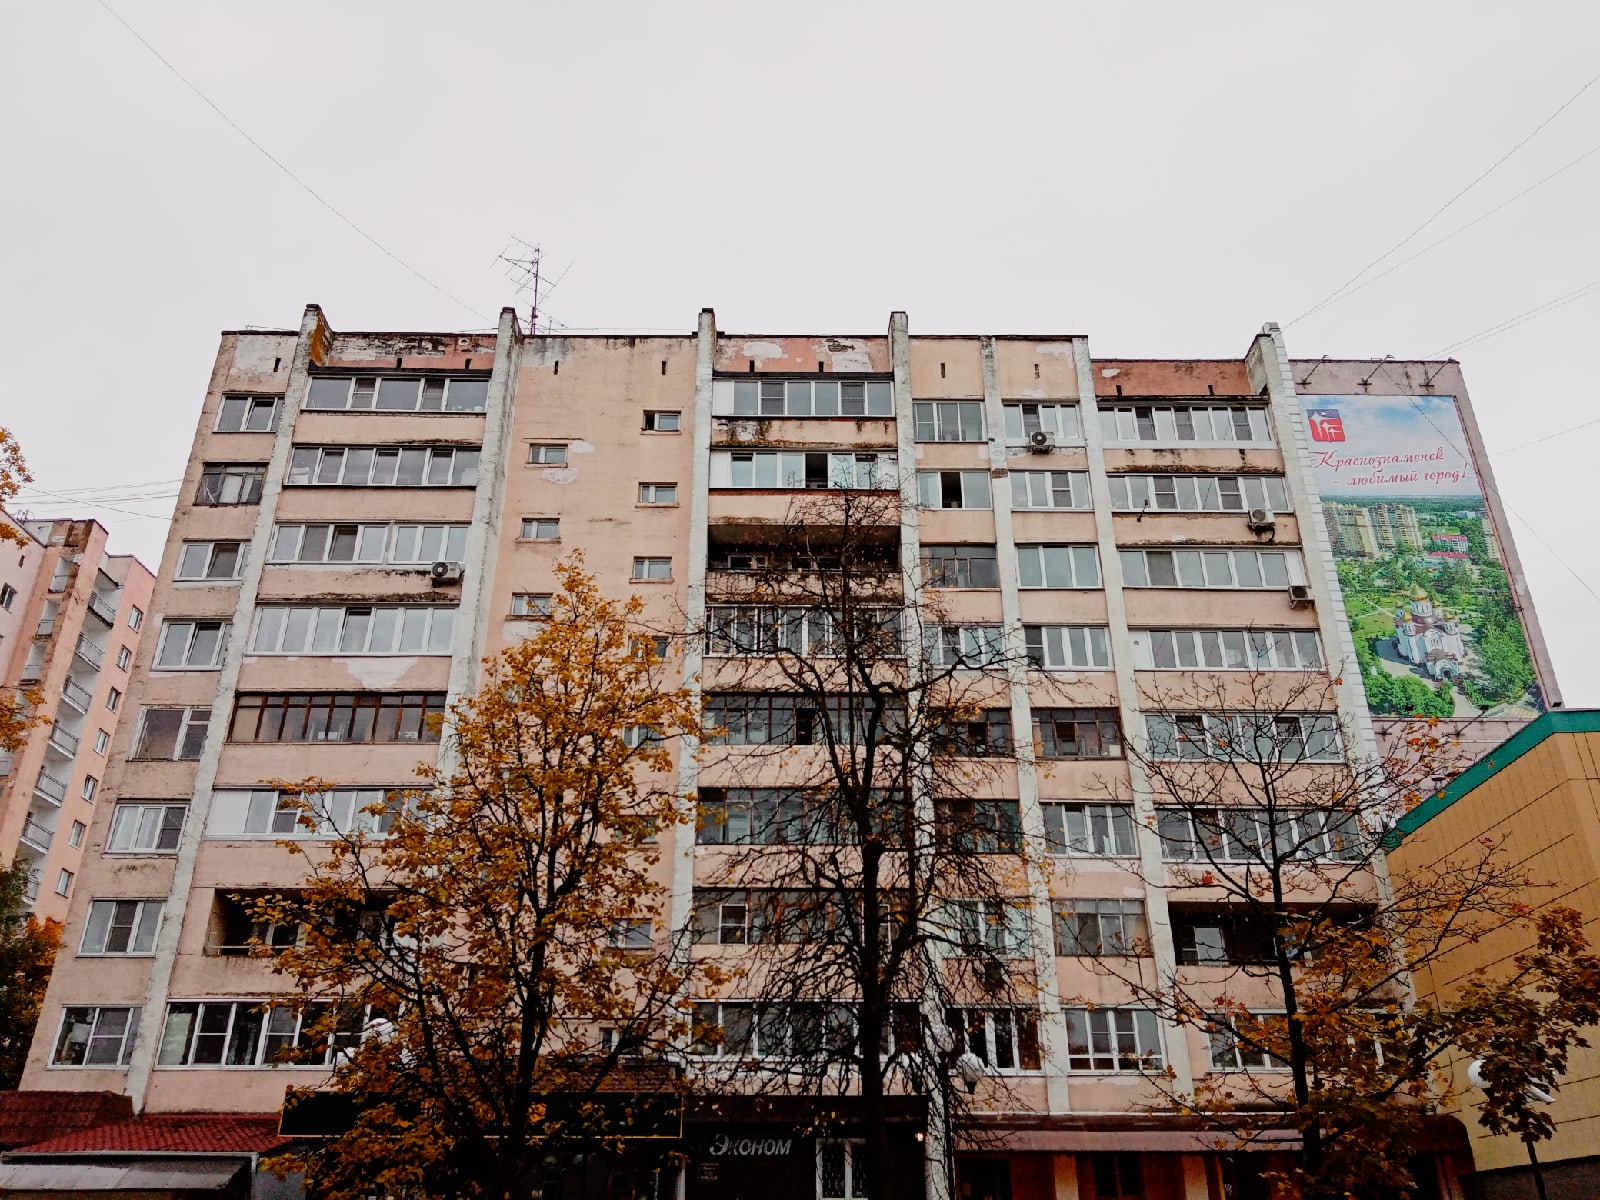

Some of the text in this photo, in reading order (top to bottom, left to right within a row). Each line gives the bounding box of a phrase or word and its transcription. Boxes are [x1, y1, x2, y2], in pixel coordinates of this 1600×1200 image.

[1308, 447, 1445, 472] Краснознаменск
[1347, 467, 1419, 486] любимый
[1423, 462, 1468, 485] город!
